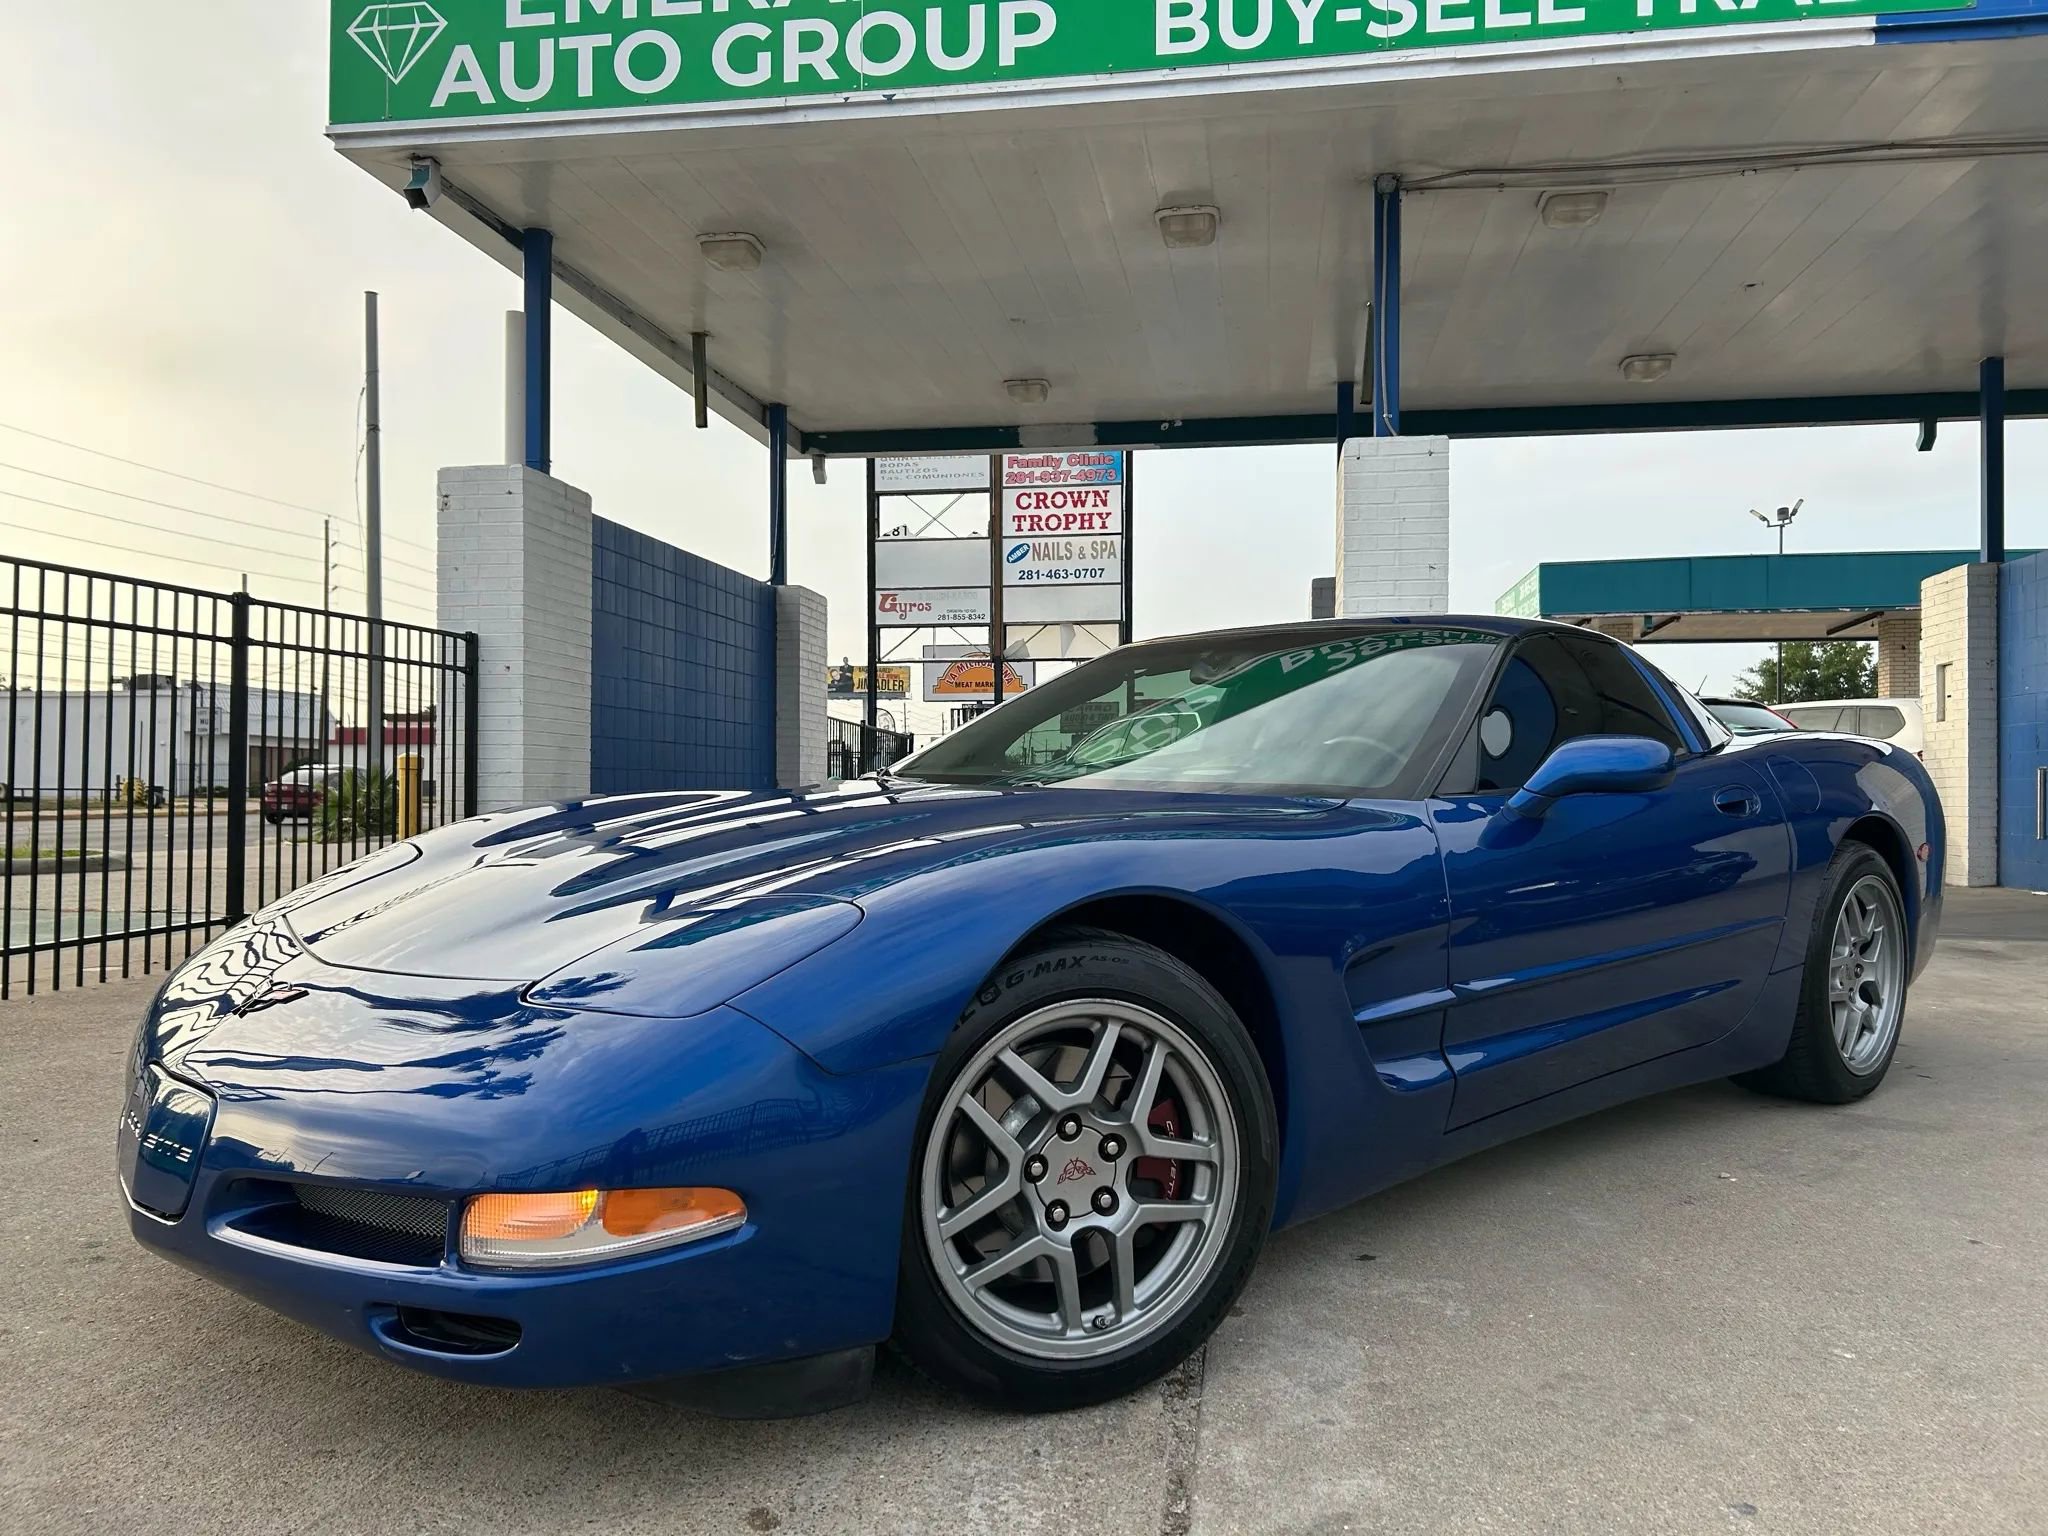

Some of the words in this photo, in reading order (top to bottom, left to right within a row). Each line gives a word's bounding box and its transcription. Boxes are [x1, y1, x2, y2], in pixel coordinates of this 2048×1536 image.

[429, 29, 682, 108] AUTO
[711, 0, 1058, 87] GROUP
[1007, 454, 1063, 471] Family
[1066, 453, 1115, 467] Clinic
[905, 472, 985, 480] COMUNIONES
[1004, 468, 1117, 485] 281-937-4973
[1015, 490, 1110, 510] CROWN
[1012, 512, 1112, 532] TROPHY
[1008, 544, 1030, 562] AMBER
[1032, 541, 1073, 561] NAILS
[1078, 545, 1087, 559] &
[1090, 540, 1117, 559] SPA
[1018, 567, 1105, 580] 281-463-0707
[878, 593, 932, 620] Gyros
[937, 613, 986, 621] 281-855-8342
[946, 672, 958, 685] LA
[956, 661, 1014, 685] MICHOANA
[876, 679, 905, 691] ADLER
